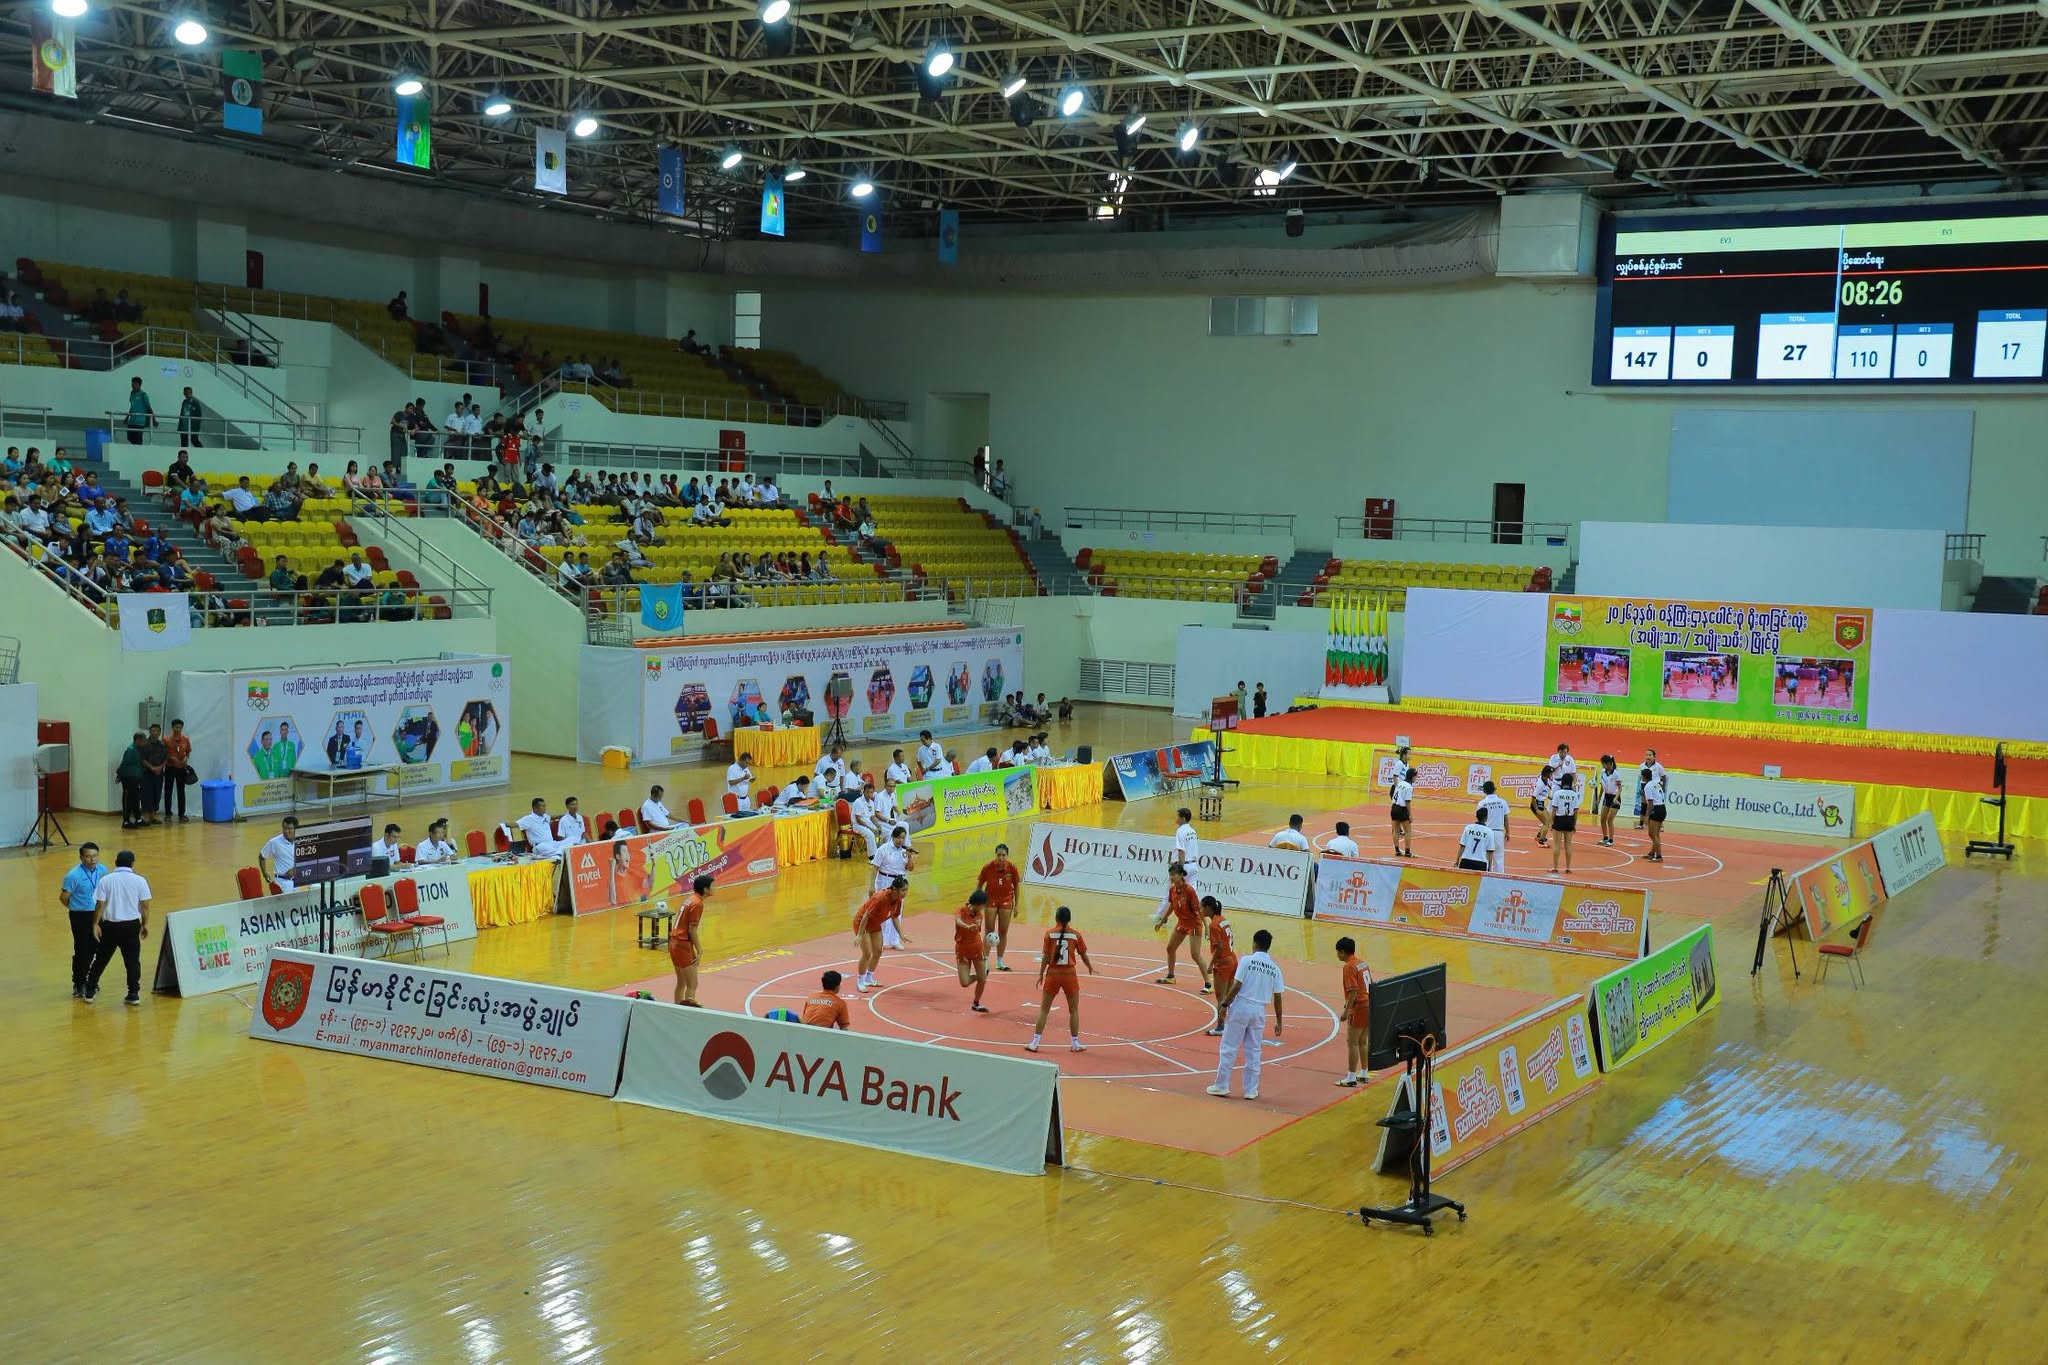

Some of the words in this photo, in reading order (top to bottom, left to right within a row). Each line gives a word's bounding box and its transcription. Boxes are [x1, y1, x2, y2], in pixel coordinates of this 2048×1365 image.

[1841, 280, 1903, 306] 08:26
[1624, 352, 1658, 367] 147
[1697, 351, 1708, 367] 0
[1782, 345, 1808, 361] 27
[1850, 351, 1878, 367] 110
[1918, 350, 1927, 367] 0
[2001, 343, 2021, 360] 17
[1669, 791, 1683, 804] Co
[1685, 793, 1700, 806] Co
[1702, 794, 1730, 812] Light
[1735, 797, 1771, 813] House
[1773, 799, 1817, 818] Co.,Ltd.
[295, 845, 317, 857] 08:26
[1471, 838, 1481, 854] 7
[665, 839, 710, 881] 120%
[1064, 837, 1123, 860] HOTEL
[1240, 858, 1301, 881] DAING
[1118, 871, 1161, 886] YANGON
[1215, 882, 1239, 896] TAW
[1424, 904, 1444, 917] iFit
[239, 911, 287, 937] ASIAN
[243, 947, 257, 958] Ph
[326, 965, 581, 1037] မြန်မာနိုင်ငံခြင်းလုံးအဖွဲ့ချုပ်
[315, 1029, 351, 1046] E-mail
[360, 1037, 587, 1084] myanmarchinlonefederation@gmail.com
[764, 1050, 849, 1102] AYA
[860, 1065, 962, 1122] Bank
